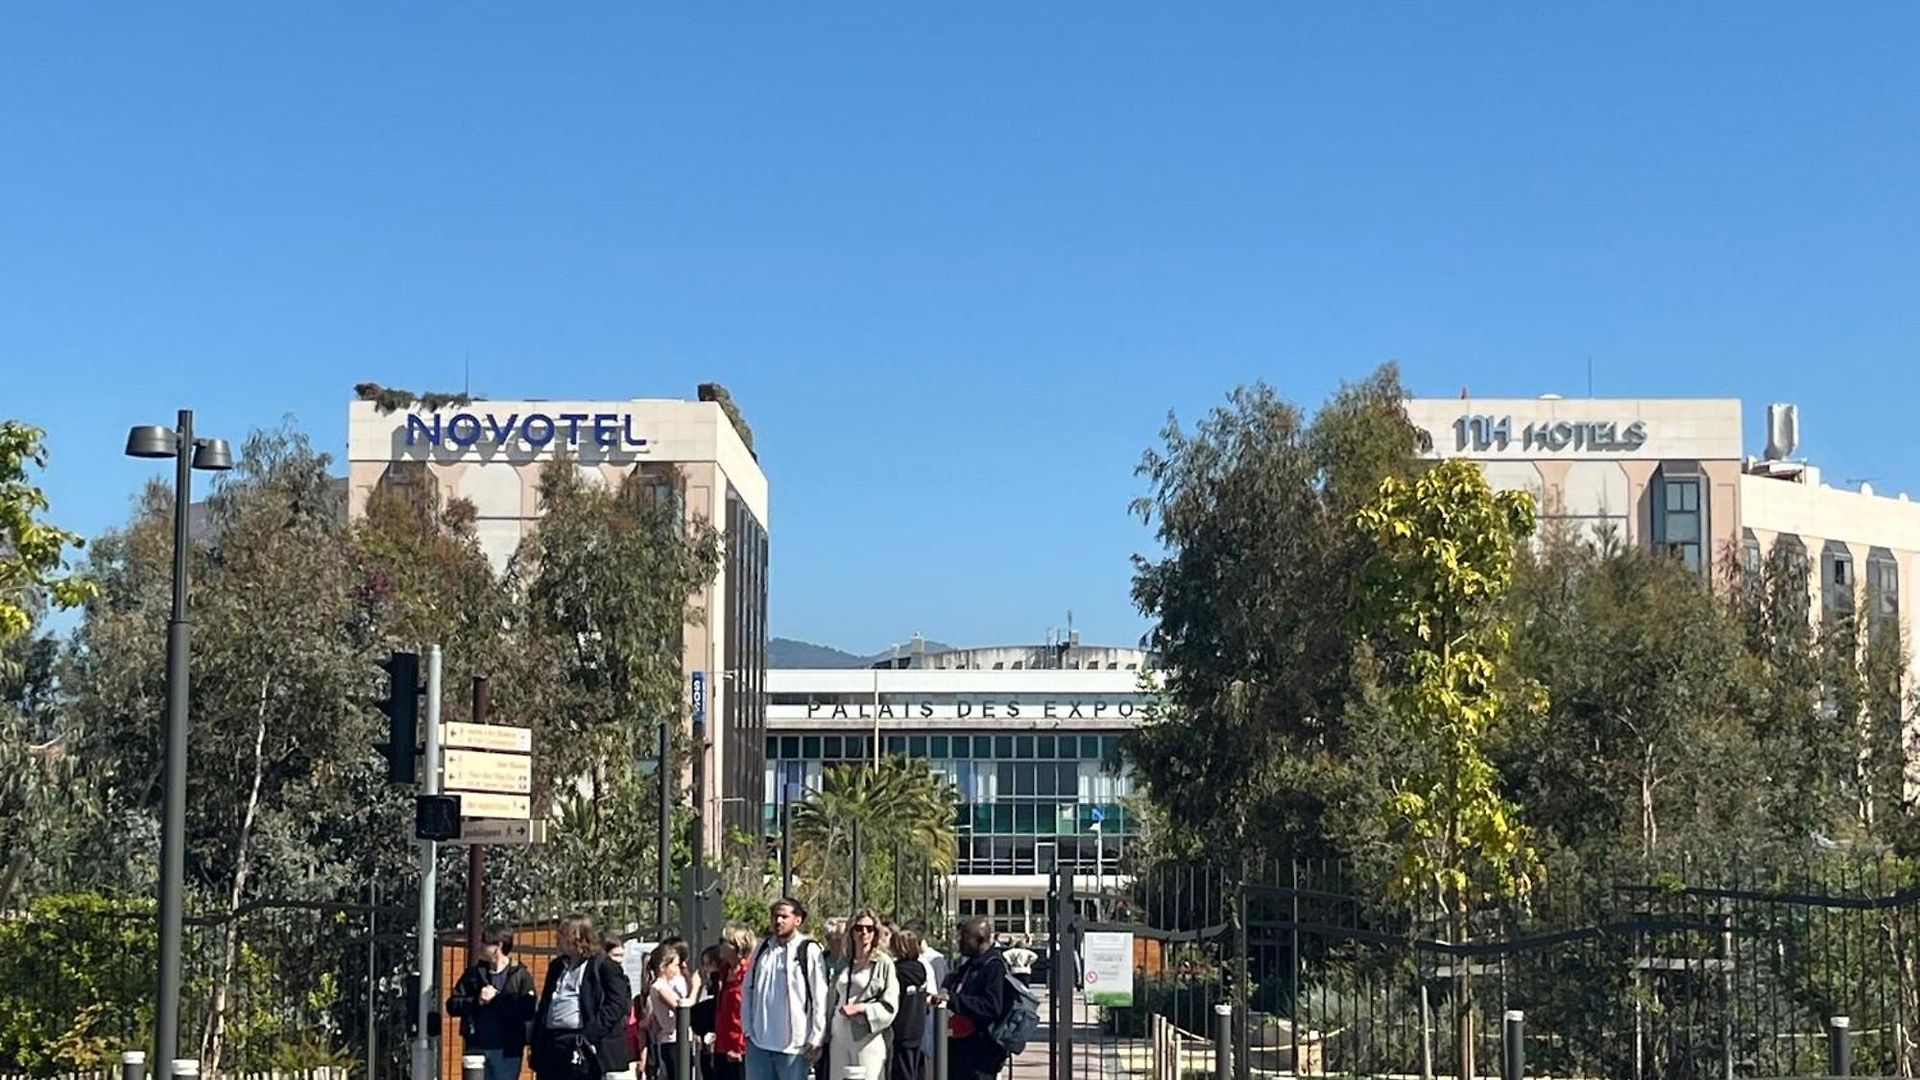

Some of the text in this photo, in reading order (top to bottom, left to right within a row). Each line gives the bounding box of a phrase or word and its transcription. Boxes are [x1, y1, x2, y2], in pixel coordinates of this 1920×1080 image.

[406, 413, 647, 446] NOVOTEL
[1455, 414, 1648, 448] NH HOTELS
[807, 700, 935, 719] PALAIS
[957, 700, 1021, 719] DES
